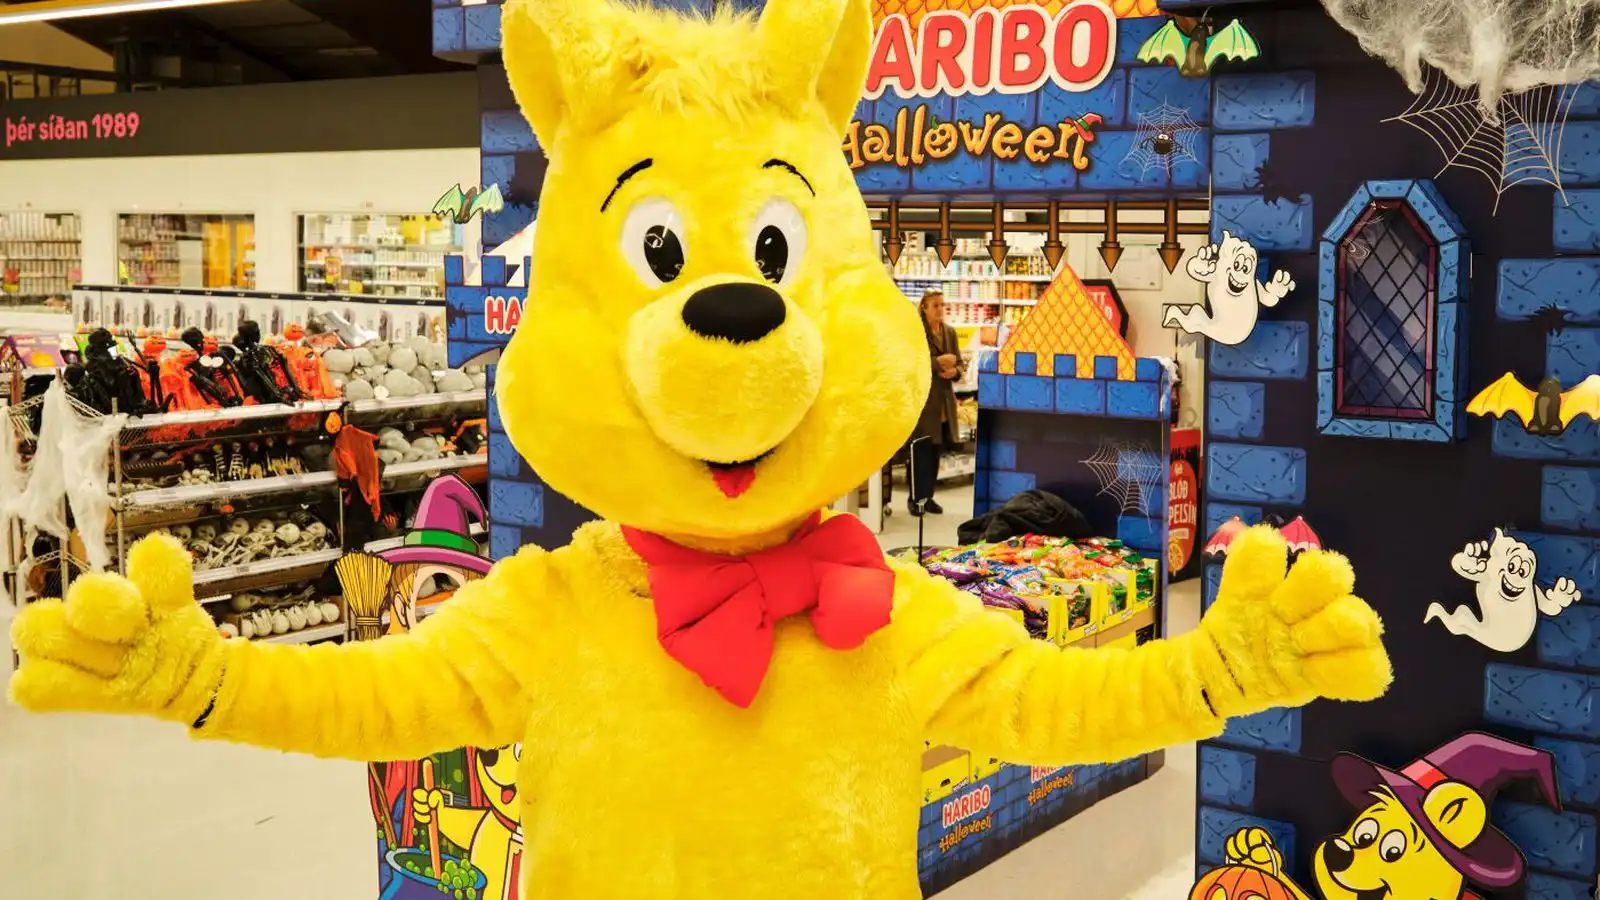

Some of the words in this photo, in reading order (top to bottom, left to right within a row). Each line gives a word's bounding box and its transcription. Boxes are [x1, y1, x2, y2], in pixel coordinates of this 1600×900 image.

[864, 4, 1109, 93] ARIBO
[6, 115, 36, 148] þér
[39, 114, 88, 141] síðan
[91, 111, 140, 139] 1989
[943, 785, 991, 828] HARIBO
[939, 812, 992, 853] Halloween
